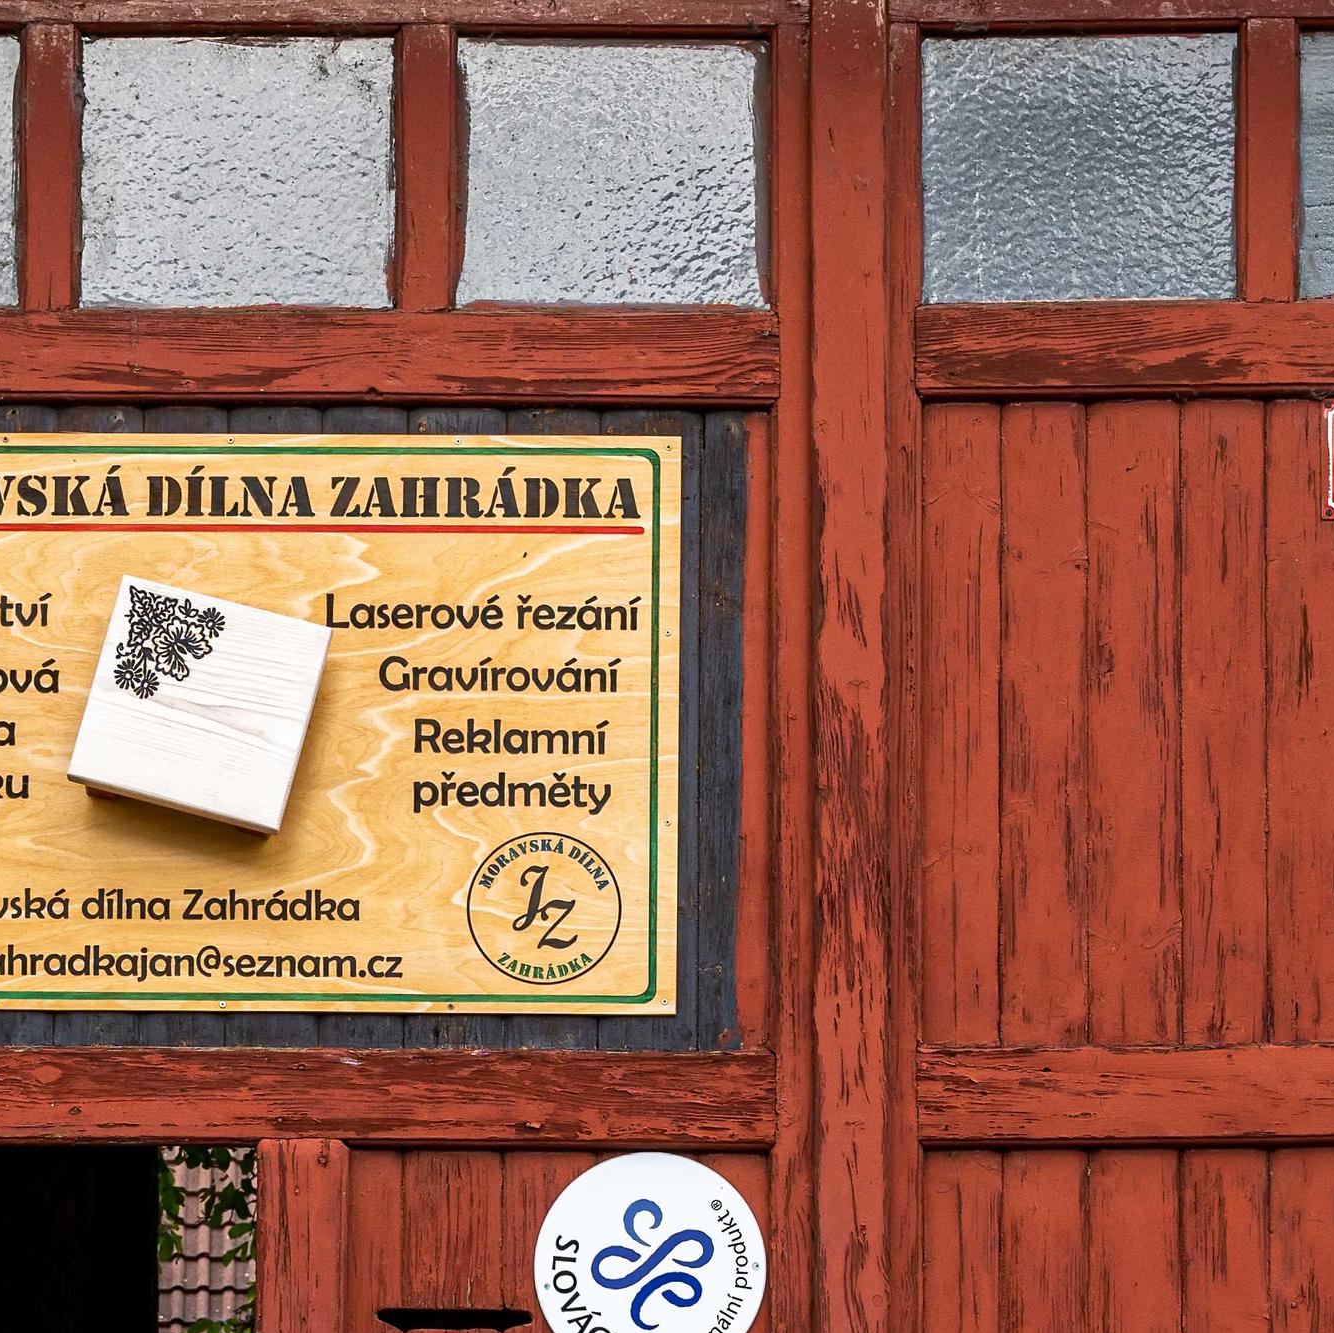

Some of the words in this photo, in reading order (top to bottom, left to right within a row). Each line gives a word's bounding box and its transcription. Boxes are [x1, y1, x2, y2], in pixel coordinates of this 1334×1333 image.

[146, 464, 316, 518] DÍLNA
[331, 466, 641, 519] ZAHRÁDKA
[325, 593, 503, 631] Laserové
[517, 594, 642, 631] řezání
[378, 655, 622, 693] Gravírování
[413, 718, 610, 755] Reklamní
[413, 771, 612, 815] předměty
[478, 838, 564, 890] MORAVSKÁ
[568, 845, 610, 891] DÍLNA
[81, 888, 171, 920] dílna
[182, 889, 360, 921] Zahrádka
[497, 952, 593, 980] ZAHRÁDKA
